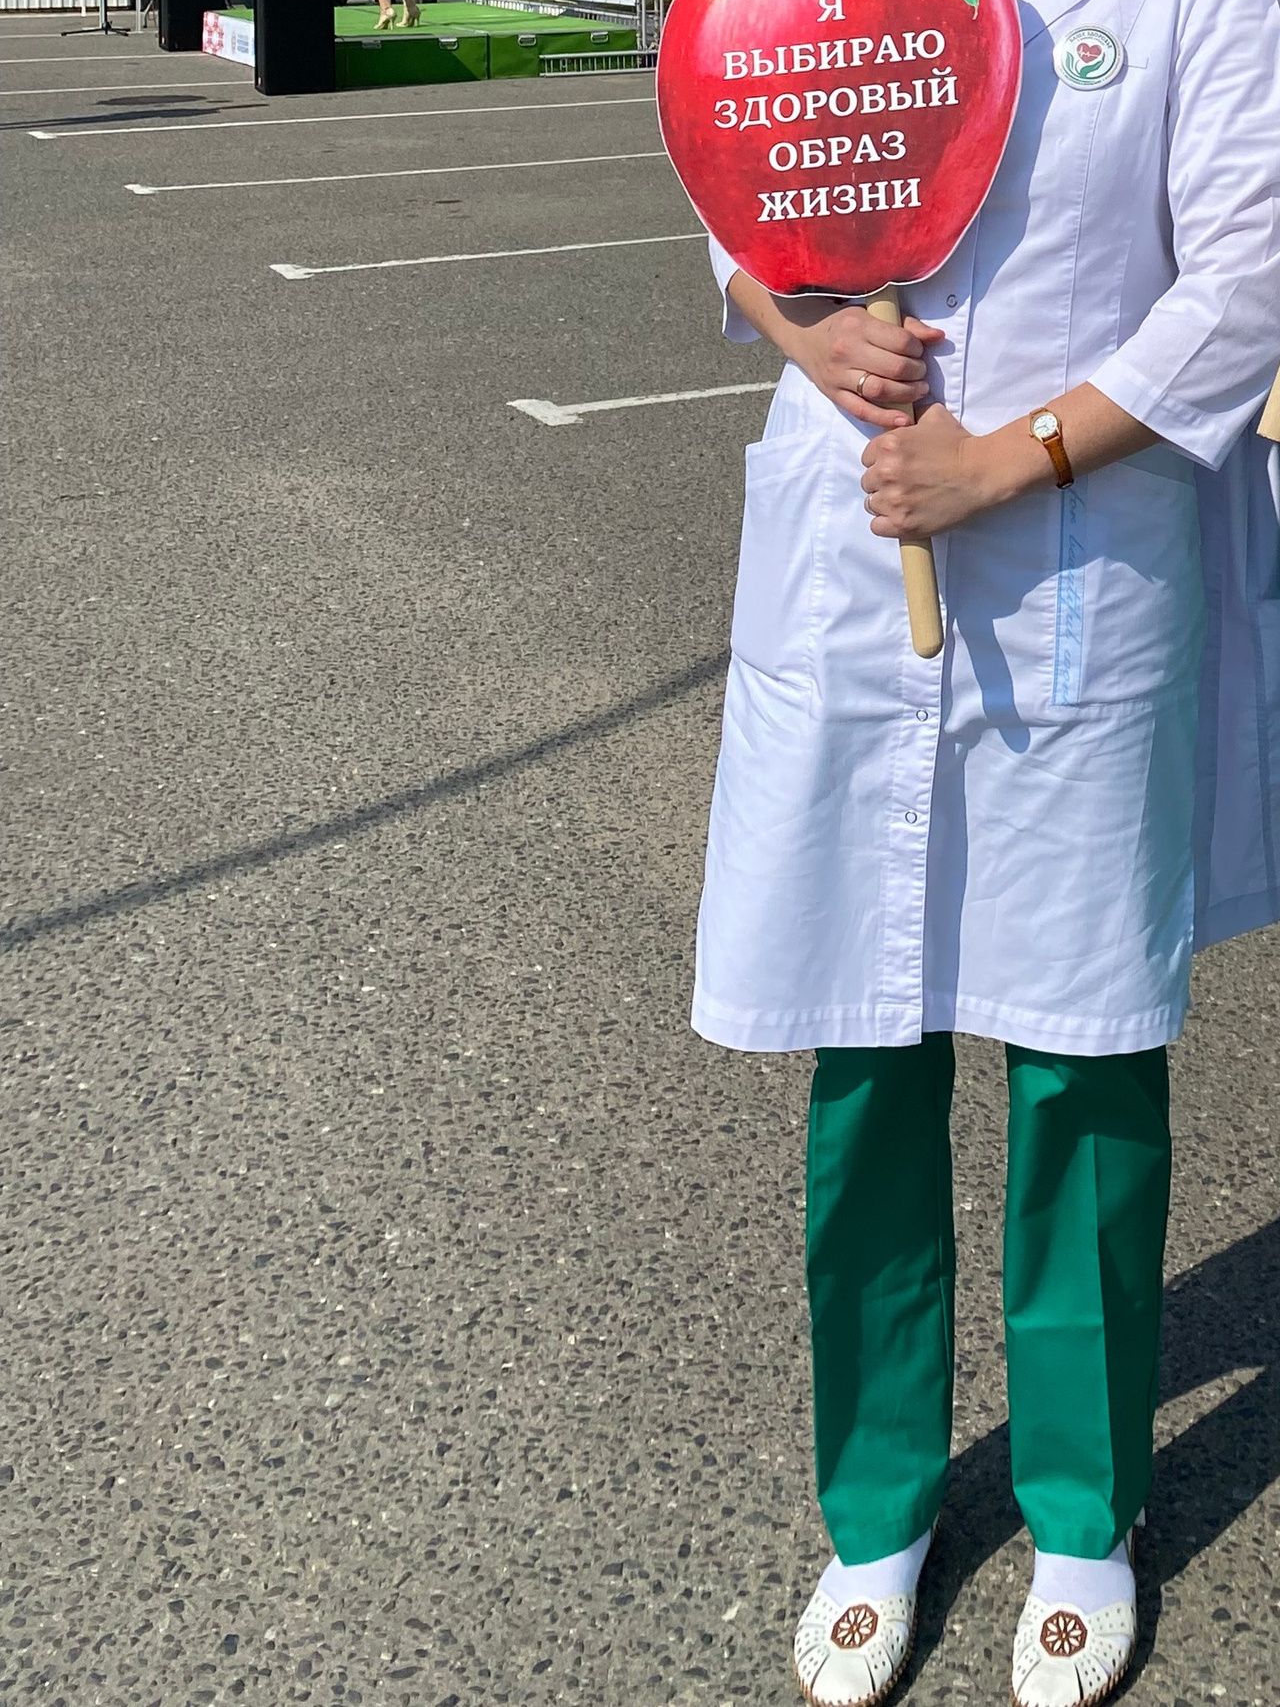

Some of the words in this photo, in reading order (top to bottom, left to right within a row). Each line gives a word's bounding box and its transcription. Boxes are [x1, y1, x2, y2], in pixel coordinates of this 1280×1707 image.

[723, 29, 946, 81] ВЫБИРАЮ
[713, 67, 960, 132] ЗДОРОВЫЙ
[768, 130, 907, 172] ОБРАЗ
[757, 177, 922, 223] ЖИЗНИ
